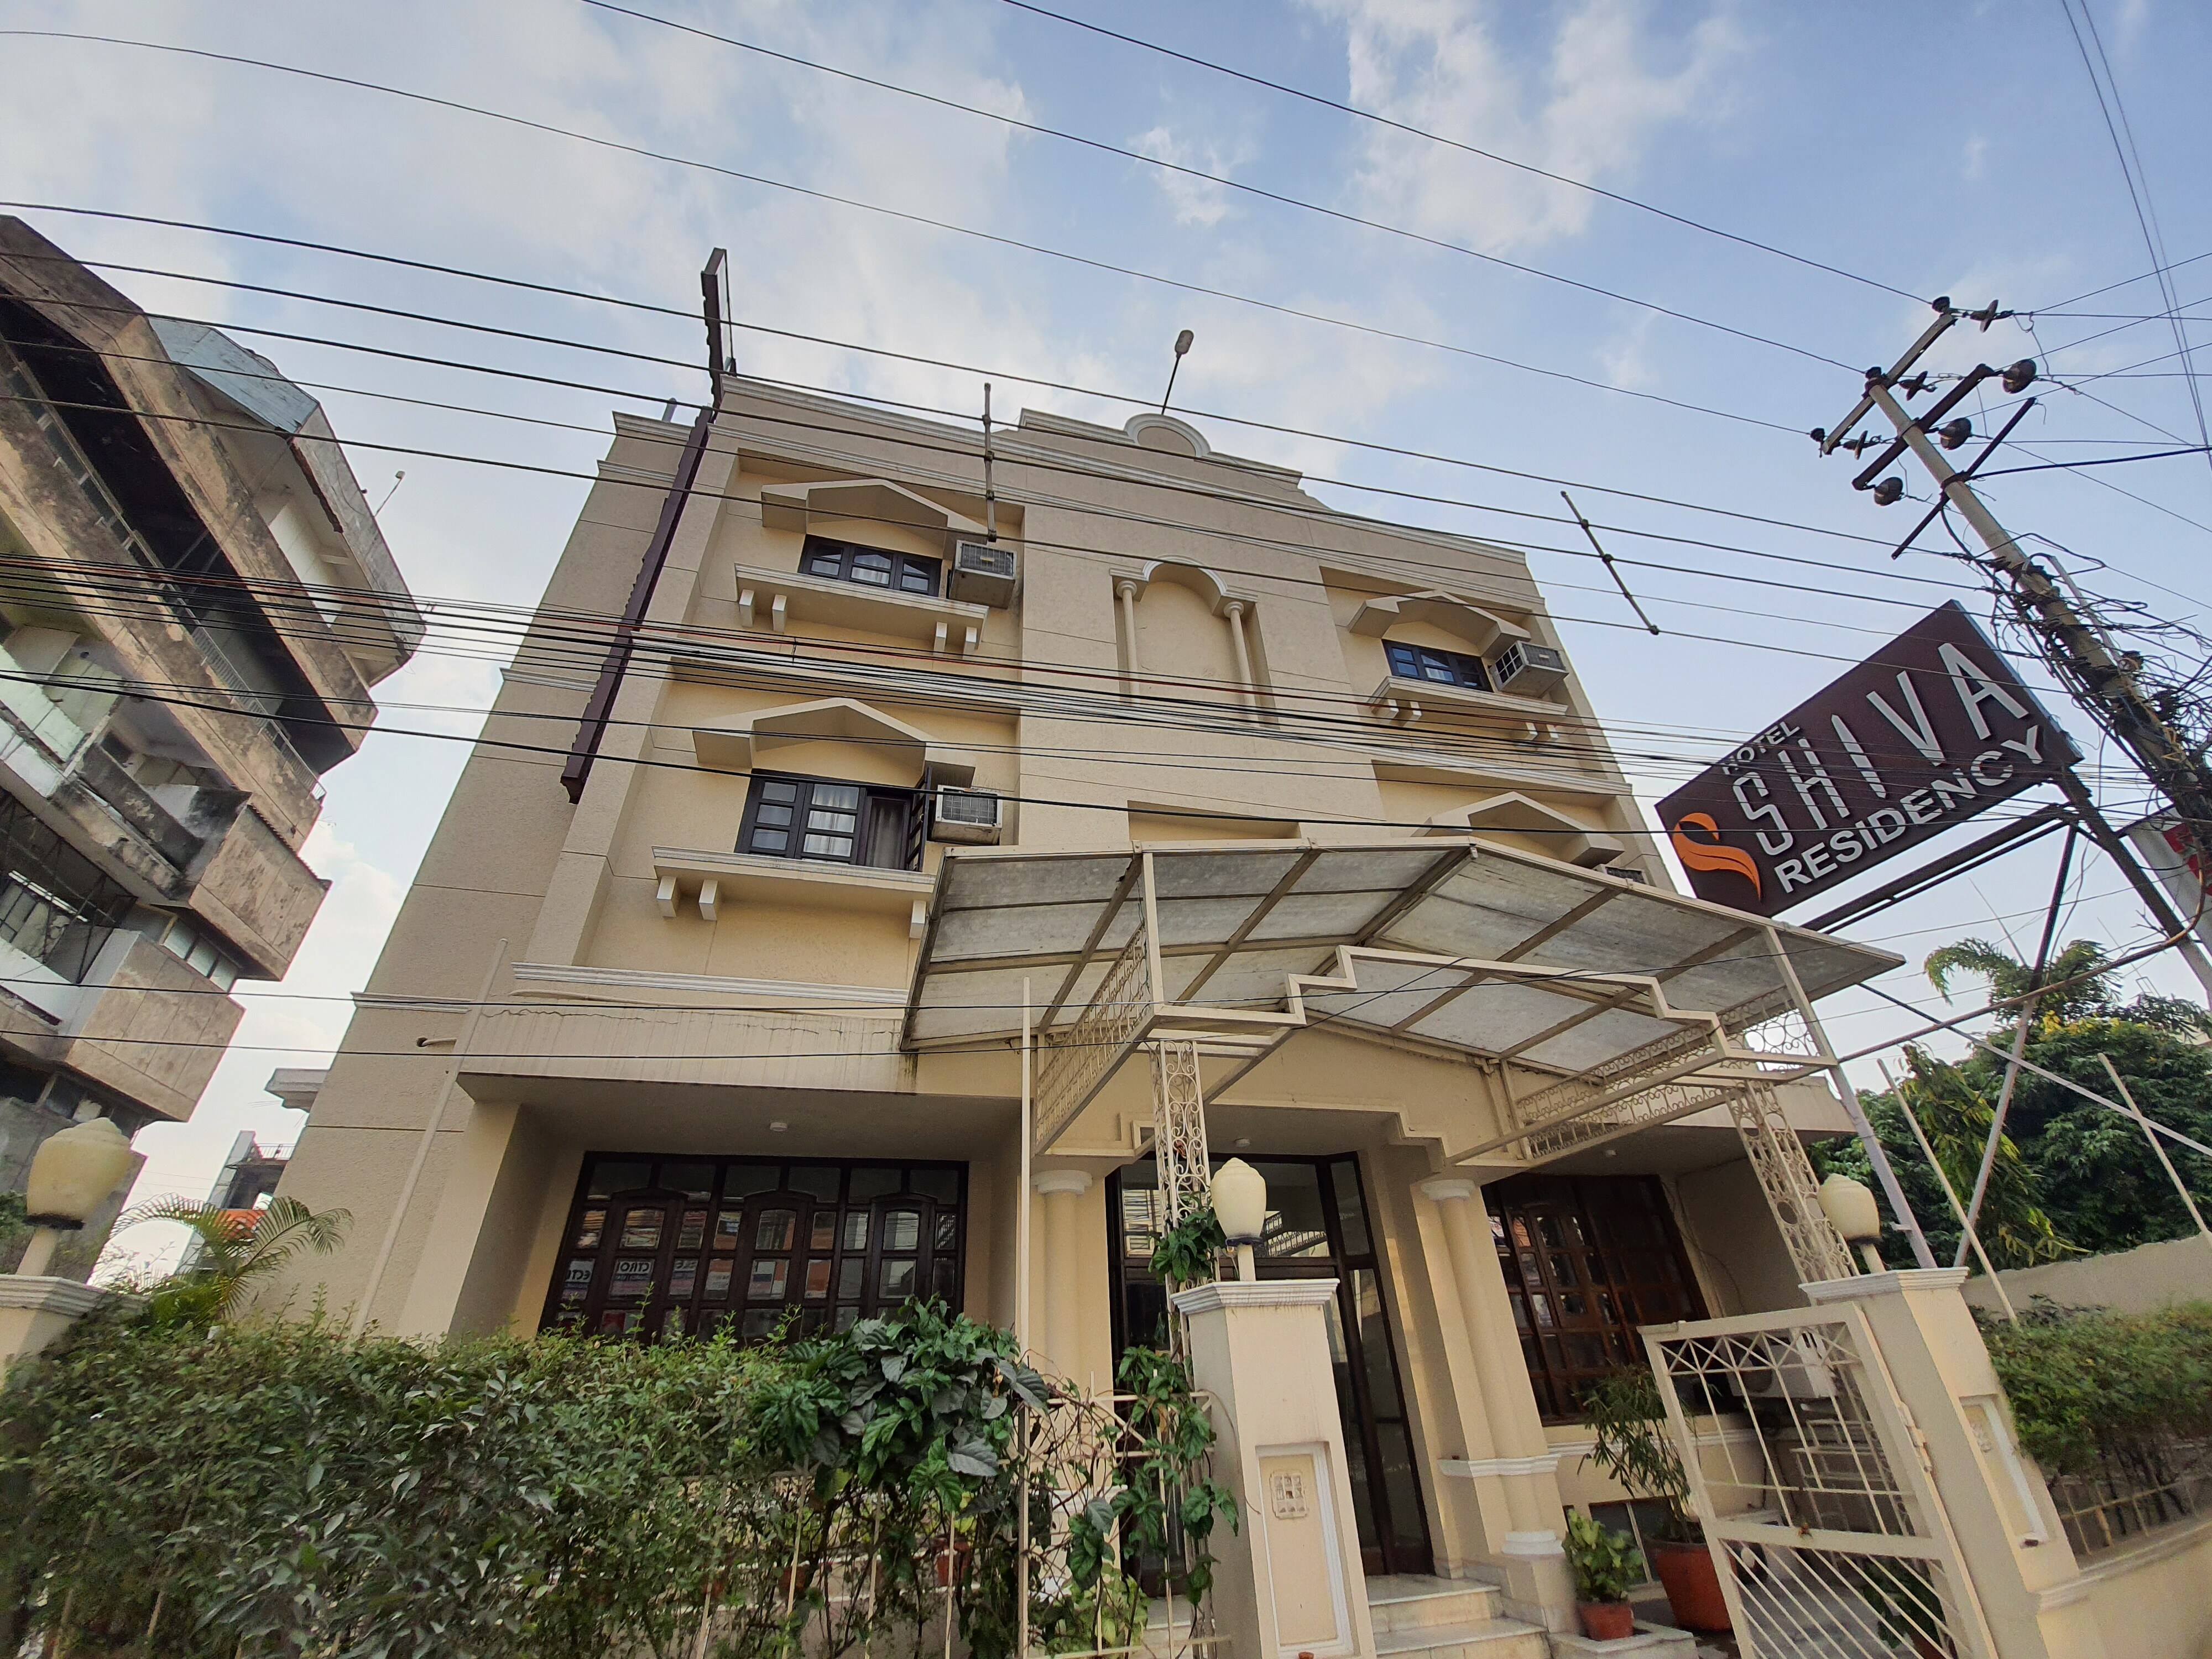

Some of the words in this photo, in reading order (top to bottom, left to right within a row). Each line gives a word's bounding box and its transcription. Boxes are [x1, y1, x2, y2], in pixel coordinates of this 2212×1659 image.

[1720, 721, 1800, 775] HOTEL
[1733, 643, 2029, 855] SHIVA
[1774, 724, 2043, 894] RESIDENCY
